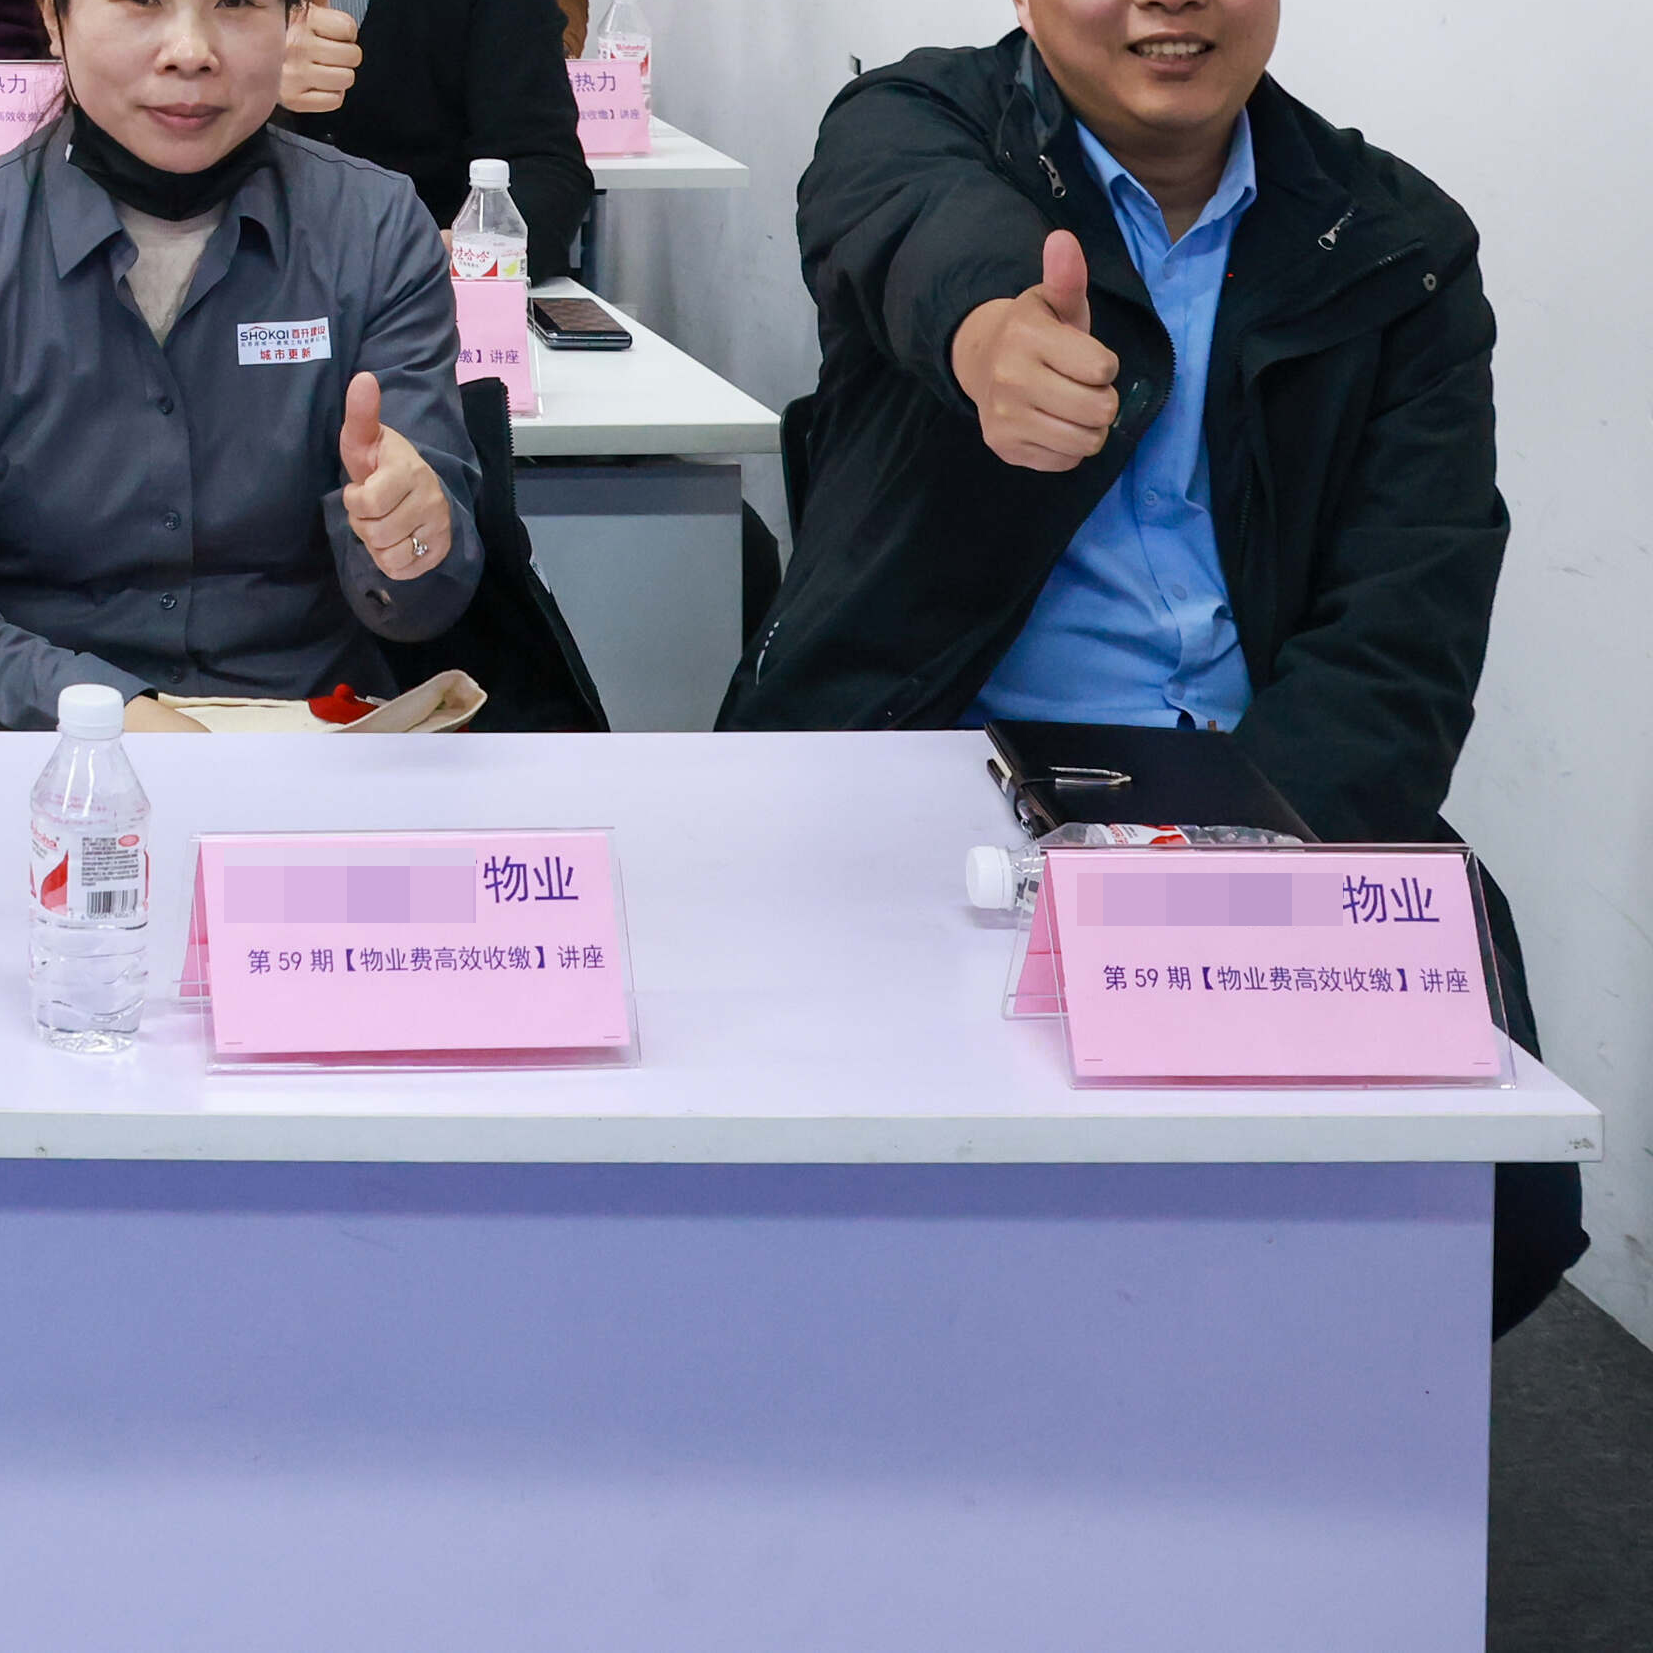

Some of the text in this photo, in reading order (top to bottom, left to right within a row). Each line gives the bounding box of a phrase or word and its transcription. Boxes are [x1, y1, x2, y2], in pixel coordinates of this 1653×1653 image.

[260, 347, 311, 360] 城市更新
[483, 854, 580, 904] 物业
[1342, 875, 1441, 925] 物业
